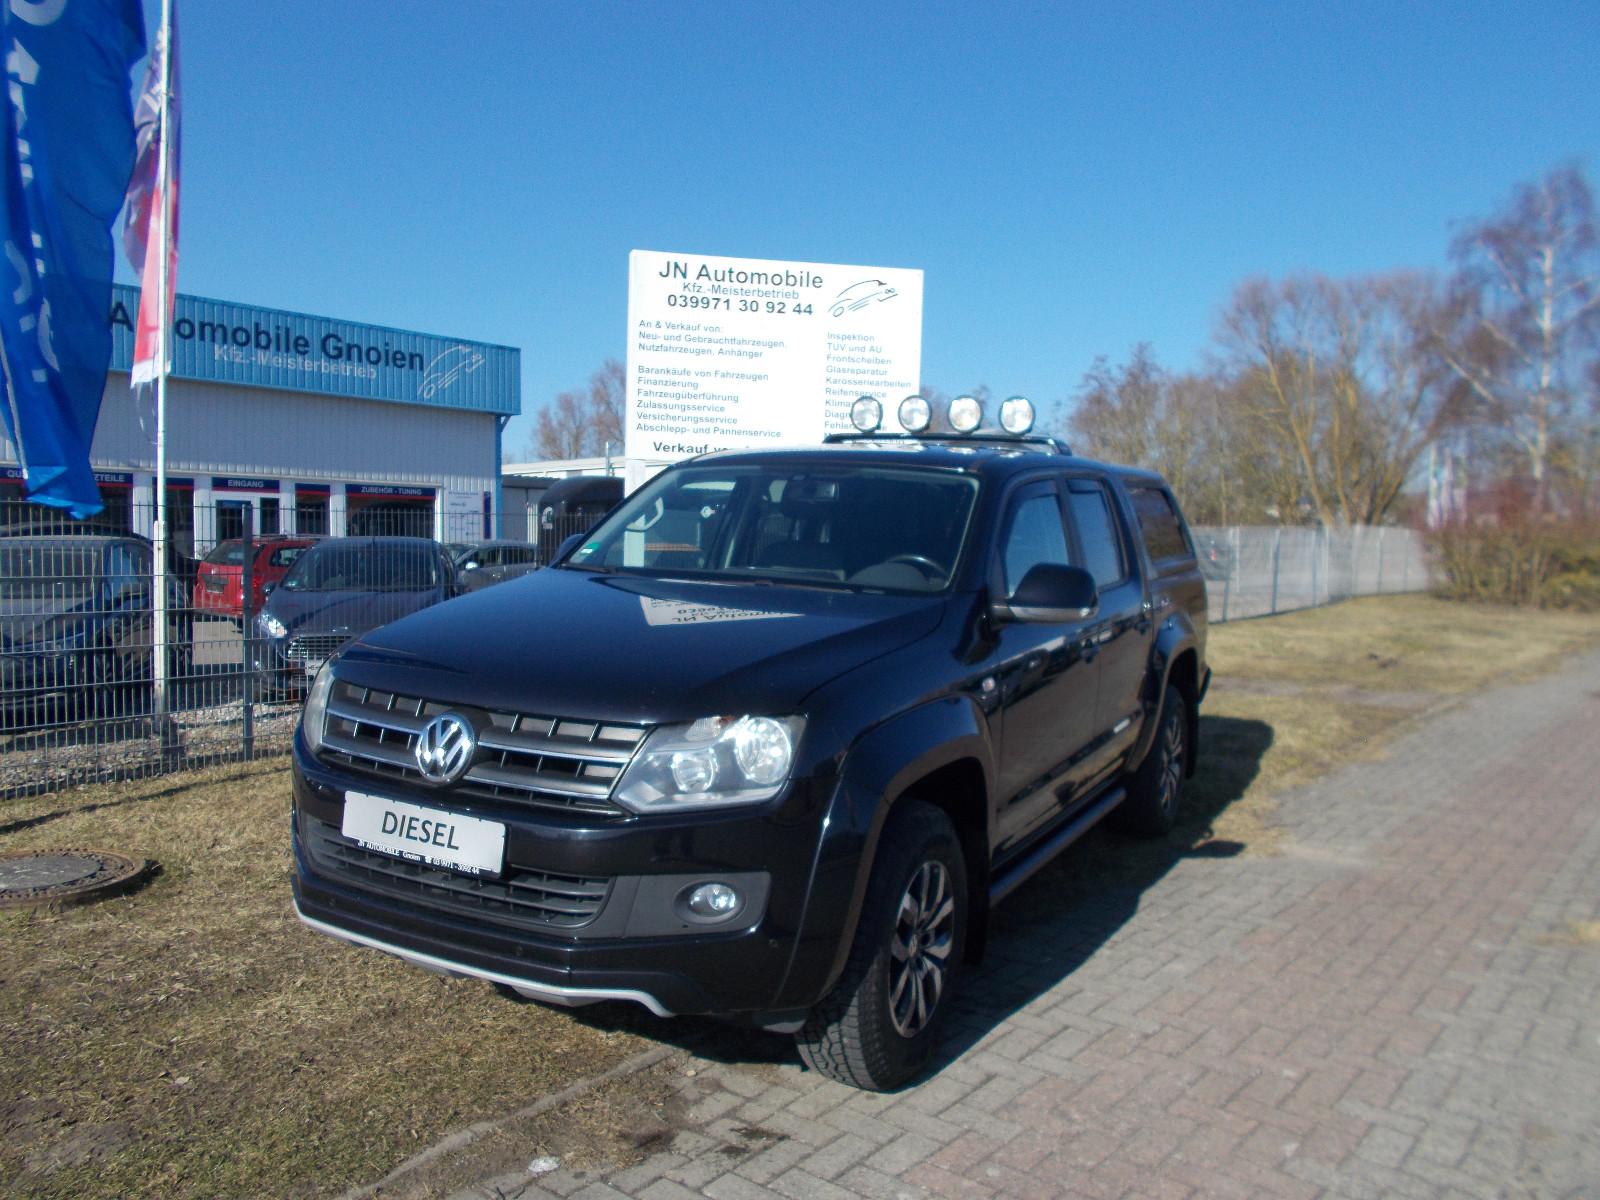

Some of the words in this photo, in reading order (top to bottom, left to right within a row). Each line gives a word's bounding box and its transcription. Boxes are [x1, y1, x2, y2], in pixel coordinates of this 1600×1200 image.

[659, 260, 688, 279] JN
[696, 264, 824, 288] Automobile
[667, 294, 731, 311] 039971
[739, 299, 759, 312] 30
[766, 301, 787, 314] 92
[792, 303, 814, 316] 44
[639, 319, 652, 328] An
[655, 320, 662, 329] &
[665, 321, 701, 331] Verkauf
[663, 334, 682, 342] und
[827, 331, 875, 342] Inspektion
[320, 333, 424, 372] Gnoien
[848, 345, 866, 353] und
[826, 353, 893, 366] Frontscheiben
[694, 370, 712, 378] von
[714, 370, 769, 382] Fahrzeugen
[826, 365, 889, 377] Glasreparatur
[637, 377, 700, 390] Finanzierung
[825, 376, 912, 389] Karosseriearbeiten
[637, 388, 739, 404] Fahrzeugüberführung
[636, 400, 726, 413] Zulassungsservice
[636, 412, 739, 426] Versicherungsservice
[636, 423, 690, 435] Abschlepp-
[692, 426, 712, 435] und
[713, 426, 782, 438] Pannenservice
[652, 441, 709, 454] Verkauf
[227, 479, 265, 489] EINGANG
[399, 486, 422, 496] TUNING
[381, 810, 460, 851] DIESEL
